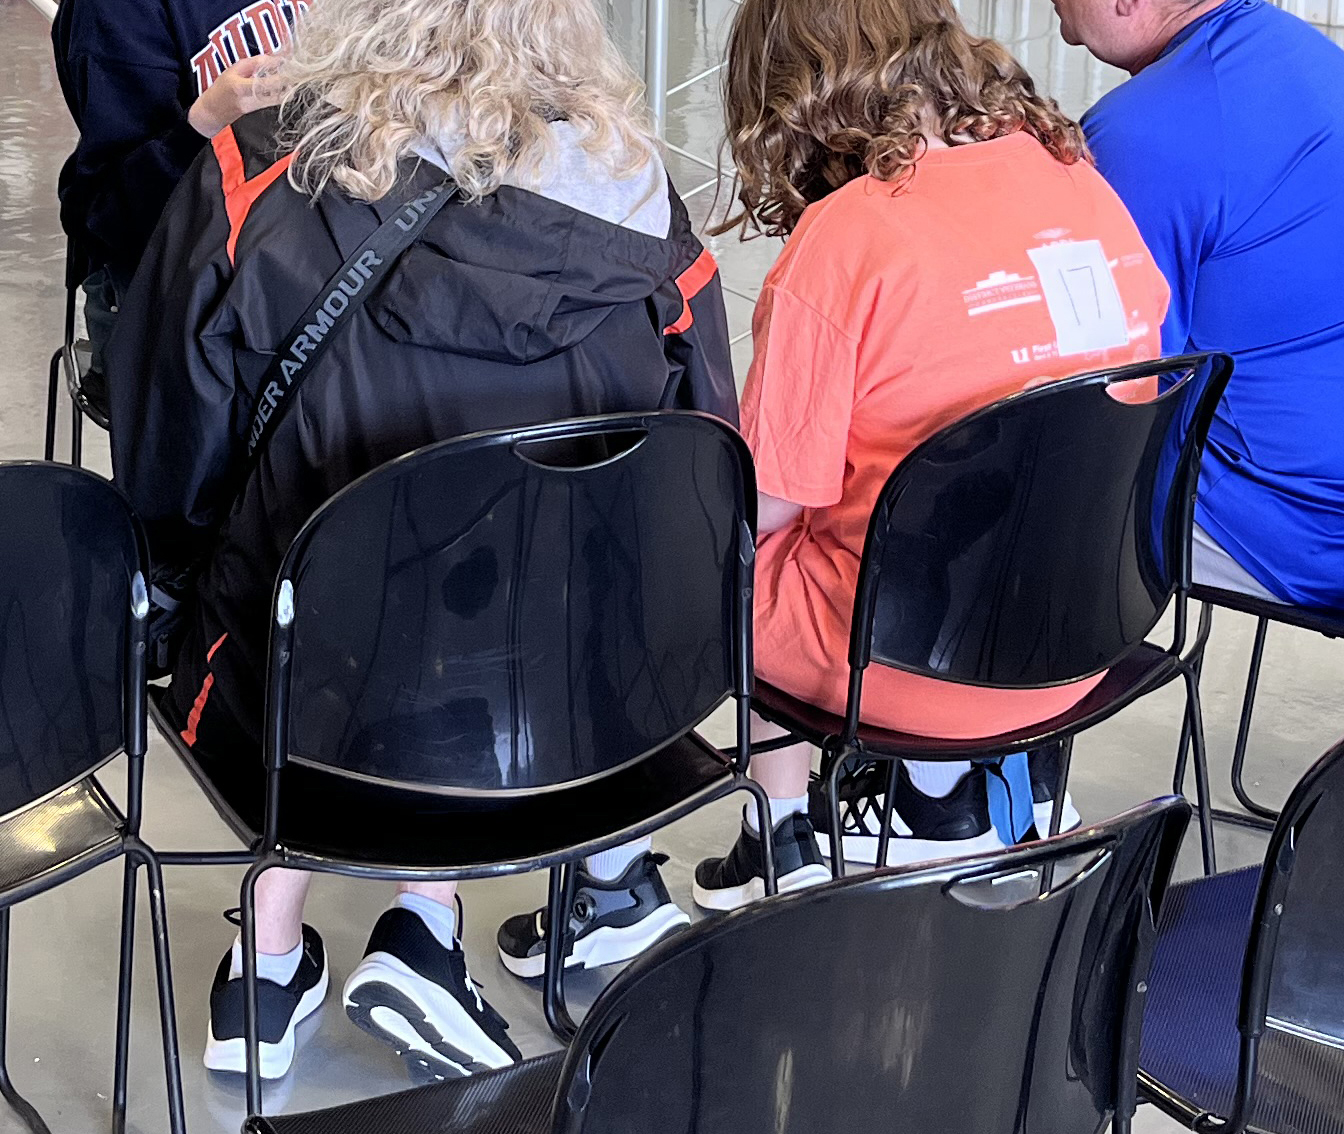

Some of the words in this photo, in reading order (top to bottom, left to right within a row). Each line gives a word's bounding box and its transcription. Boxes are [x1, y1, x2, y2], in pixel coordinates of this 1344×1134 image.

[247, 380, 285, 457] NDER
[280, 248, 384, 386] ARMOUR
[1058, 265, 1102, 326] 17
